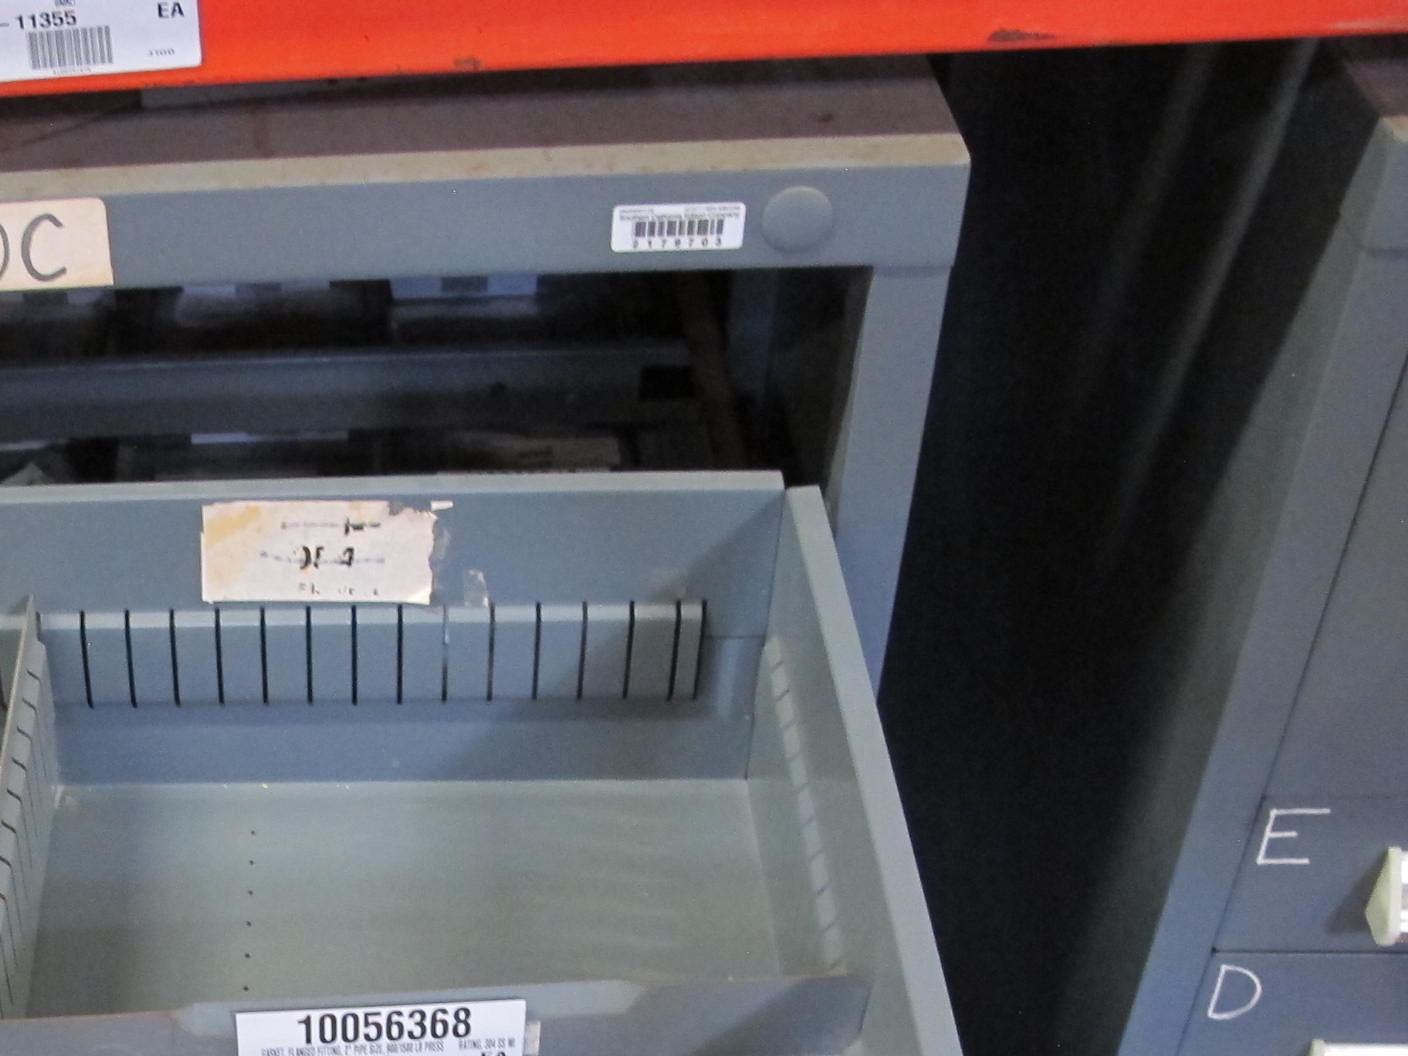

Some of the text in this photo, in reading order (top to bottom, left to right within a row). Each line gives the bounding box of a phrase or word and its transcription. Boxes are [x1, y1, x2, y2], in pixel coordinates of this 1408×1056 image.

[157, 2, 184, 18] EA
[1257, 808, 1331, 865] E
[1208, 965, 1262, 1020] D
[297, 1008, 472, 1045] 10056368
